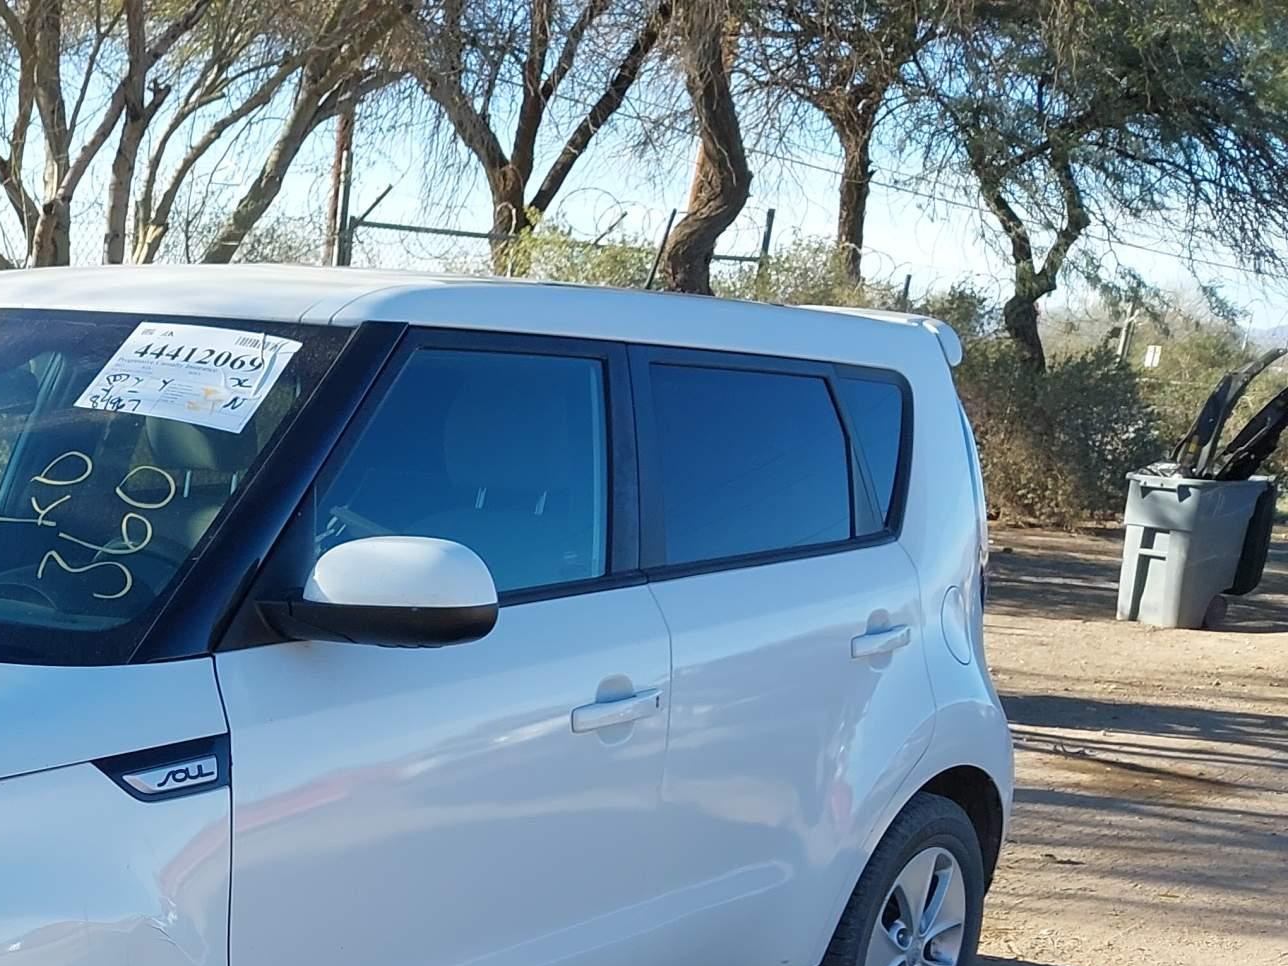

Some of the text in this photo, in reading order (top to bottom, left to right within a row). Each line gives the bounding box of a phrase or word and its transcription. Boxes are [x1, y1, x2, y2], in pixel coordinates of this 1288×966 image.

[134, 343, 263, 373] 44412069
[37, 466, 176, 599] 360
[157, 764, 215, 787] SOUL
